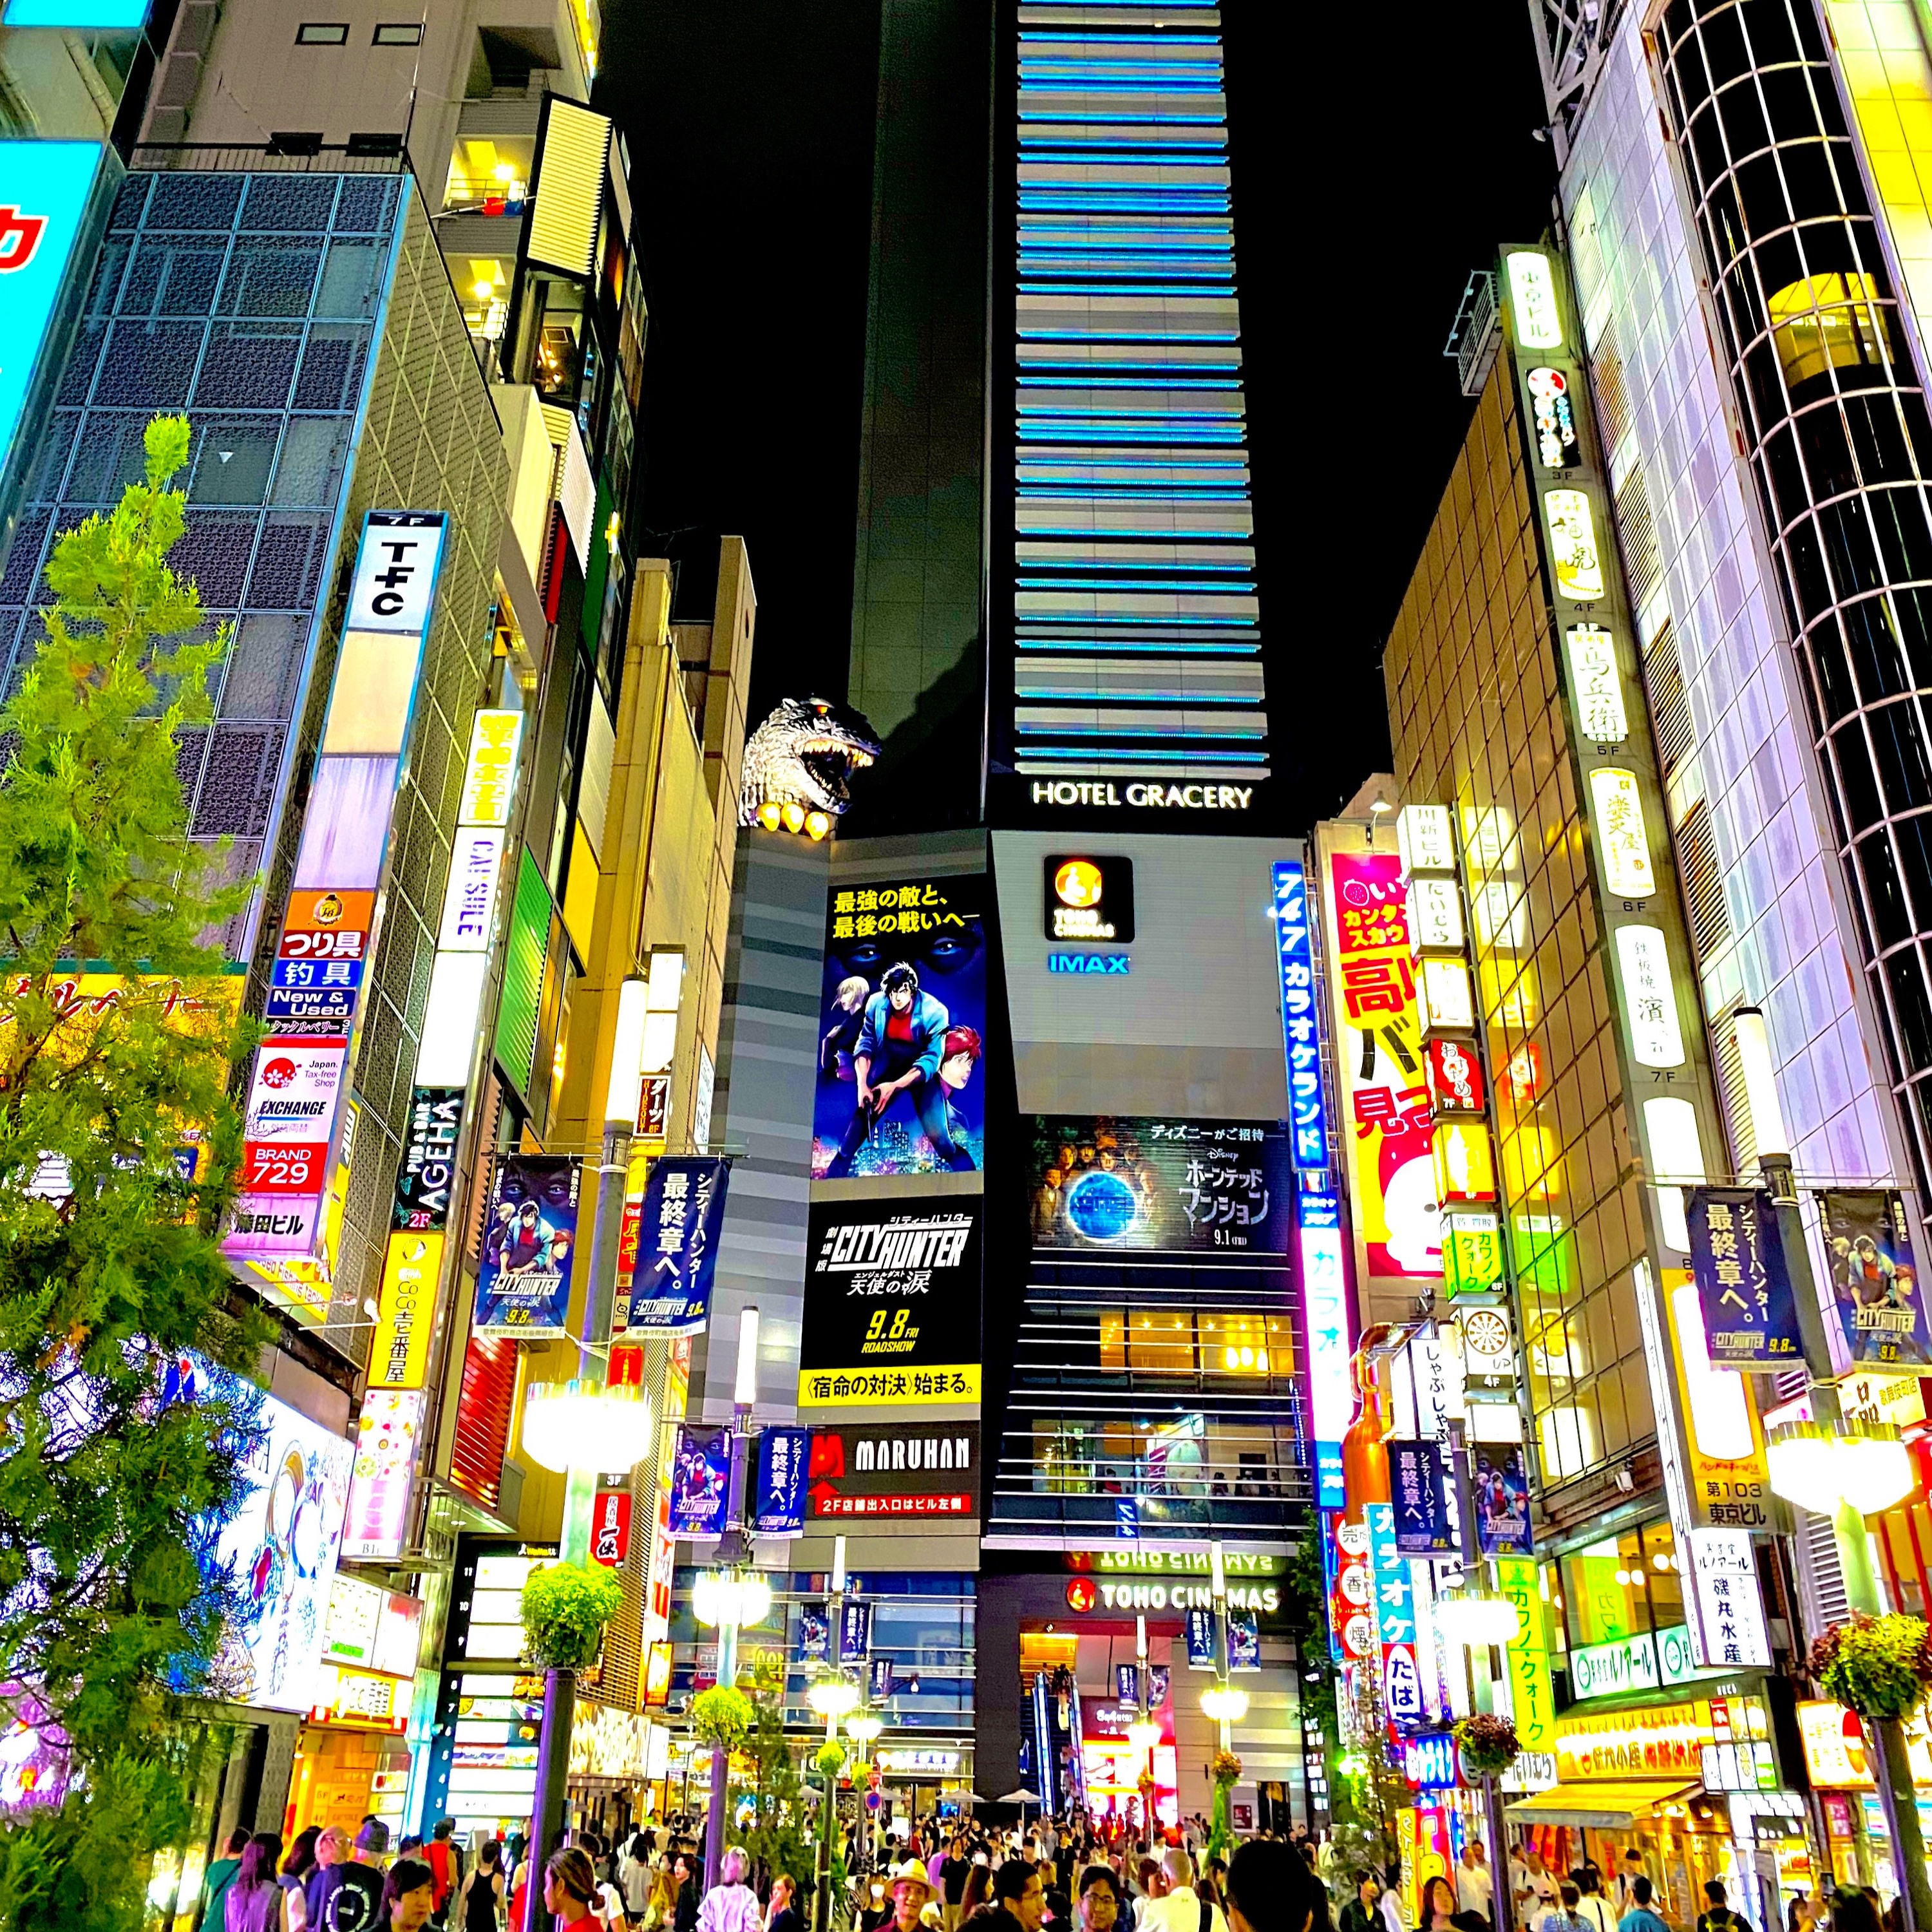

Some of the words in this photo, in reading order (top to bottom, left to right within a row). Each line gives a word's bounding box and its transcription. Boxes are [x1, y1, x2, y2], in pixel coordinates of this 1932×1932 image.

[1553, 471, 1573, 480] 3F
[388, 516, 425, 526] 7F
[1574, 603, 1595, 612] 4F
[1597, 745, 1620, 755] 5F
[1032, 782, 1122, 806] HOTEL
[1126, 783, 1253, 809] GRACERY
[457, 840, 495, 936] CASULE
[834, 884, 948, 914] 最強の敵と、
[1623, 902, 1647, 912] 6F
[1053, 909, 1099, 925] TOHO
[1053, 923, 1115, 938] CINEMAS
[285, 931, 362, 958] つり具
[1049, 954, 1129, 974] IMAX
[284, 961, 352, 986] 釣具
[273, 990, 323, 1003] New
[329, 992, 344, 1003] &
[290, 1003, 349, 1016] Used
[270, 1020, 340, 1034] タックルベリー
[304, 1070, 337, 1079] Tax-free
[1651, 1072, 1676, 1083] 7F
[314, 1079, 336, 1089] Shop
[259, 1101, 327, 1116] EXCHANGE
[639, 1079, 650, 1134] HIDEOUT
[649, 1080, 667, 1123] ダーツ
[1443, 1097, 1455, 1108] 7F
[413, 1103, 431, 1130] BAR
[255, 1149, 312, 1160] BRAND
[406, 1145, 426, 1173] PUB
[418, 1099, 459, 1212] AGEHA
[250, 1162, 309, 1184] 729
[1185, 1159, 1264, 1188] ホーンテッド
[890, 1213, 974, 1227] シティーハンター
[1179, 1188, 1270, 1235] マンション
[408, 1213, 431, 1228] 2F
[654, 1173, 690, 1290] 最終章へ。
[689, 1173, 713, 1289] シティーハンター
[1213, 1229, 1230, 1245] 9.1
[815, 1226, 839, 1273] 劇場版
[880, 1229, 970, 1269] HUNTER
[1705, 1204, 1754, 1323] 最終章へ。
[1739, 1204, 1770, 1323] シティーハンター
[854, 1270, 905, 1278] エンジェルダスト
[846, 1270, 933, 1296] 天使の涙
[866, 1309, 910, 1340] 9.8
[905, 1327, 920, 1338] FRI
[861, 1340, 916, 1354] ROADSHOW
[1483, 1374, 1500, 1388] 4F
[855, 1438, 970, 1471] MARUHAN
[606, 1475, 622, 1486] 3F
[770, 1437, 789, 1511] 最終章へ。
[790, 1437, 803, 1510] シティーハンター
[1399, 1451, 1426, 1529] 最終章へ。
[1419, 1451, 1435, 1529] シティーハンター
[1706, 1481, 1763, 1498] 第103
[822, 1497, 962, 1513] 2F店舗出入口はビル左側
[1709, 1502, 1766, 1526] 東京ビル
[464, 1567, 473, 1577] 11
[1699, 1557, 1750, 1570] ルノアール
[1374, 1506, 1413, 1643] カラオケ
[459, 1601, 469, 1611] 10
[1100, 1584, 1166, 1609] TOHO
[1170, 1586, 1279, 1611] CINMAS
[1713, 1578, 1743, 1663] 磯丸水産
[1609, 1642, 1652, 1684] ルノアール
[450, 1680, 458, 1690] 8
[448, 1703, 455, 1713] 7
[441, 1750, 449, 1761] 5
[439, 1774, 446, 1785] 4
[435, 1798, 442, 1808] 3
